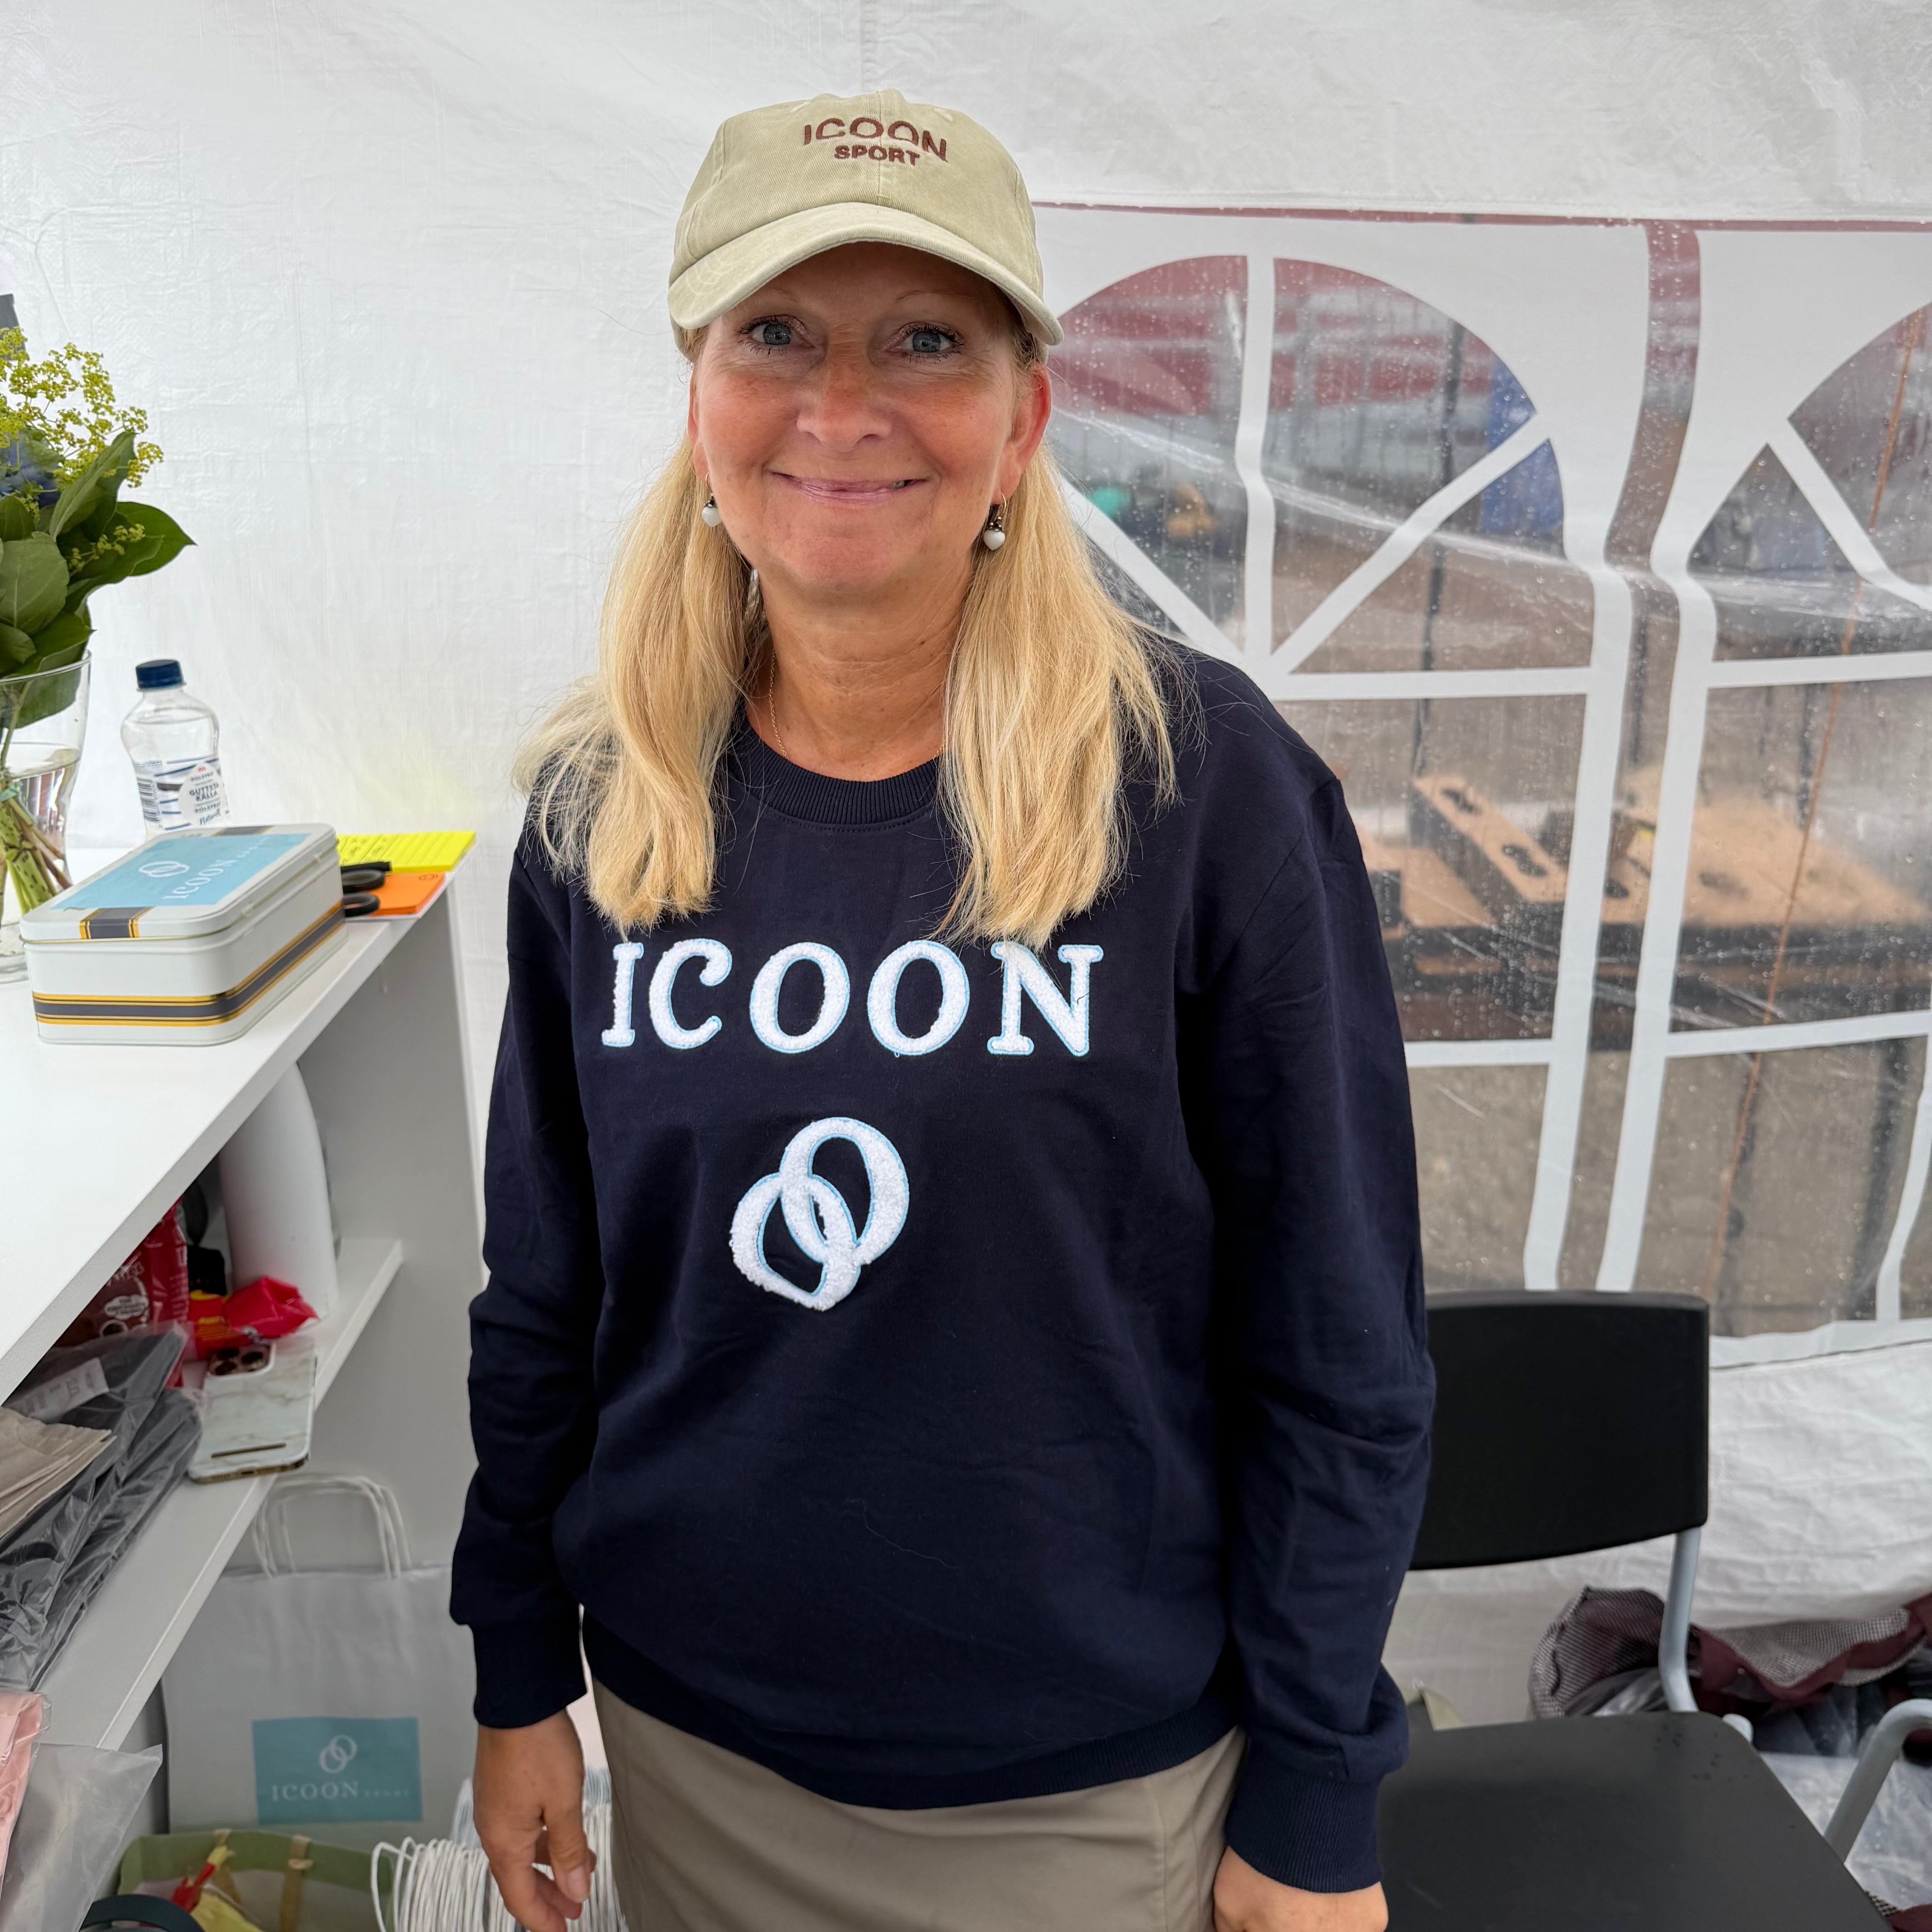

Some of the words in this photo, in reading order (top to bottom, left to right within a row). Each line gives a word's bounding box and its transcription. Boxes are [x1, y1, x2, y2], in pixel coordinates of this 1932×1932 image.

[804, 117, 948, 162] ICOON
[834, 144, 920, 166] SPORT
[162, 859, 238, 900] ICOON
[602, 938, 1104, 1056] ICOON
[271, 1781, 359, 1802] ICOON
